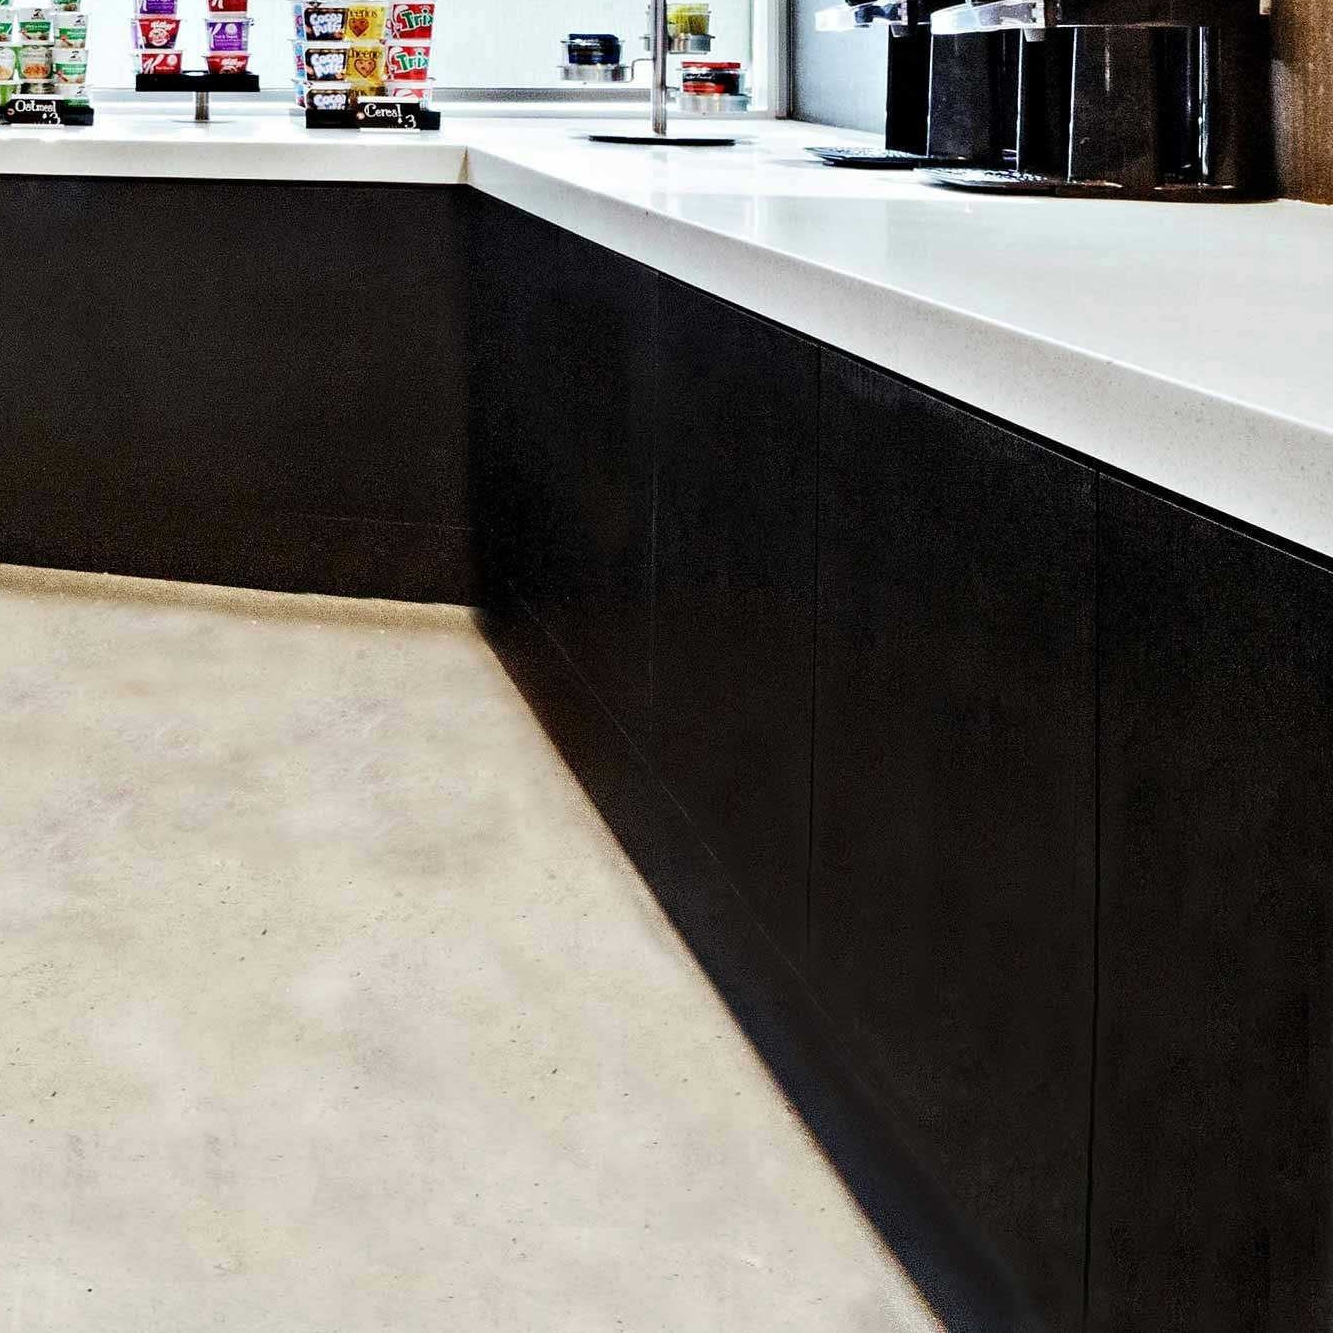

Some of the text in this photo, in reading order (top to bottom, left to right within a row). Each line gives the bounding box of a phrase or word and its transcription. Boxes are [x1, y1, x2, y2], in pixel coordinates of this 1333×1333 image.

[401, 8, 434, 28] Trix
[396, 51, 428, 71] Trix
[14, 100, 57, 112] Oatmeal
[364, 103, 402, 118] Cereal
